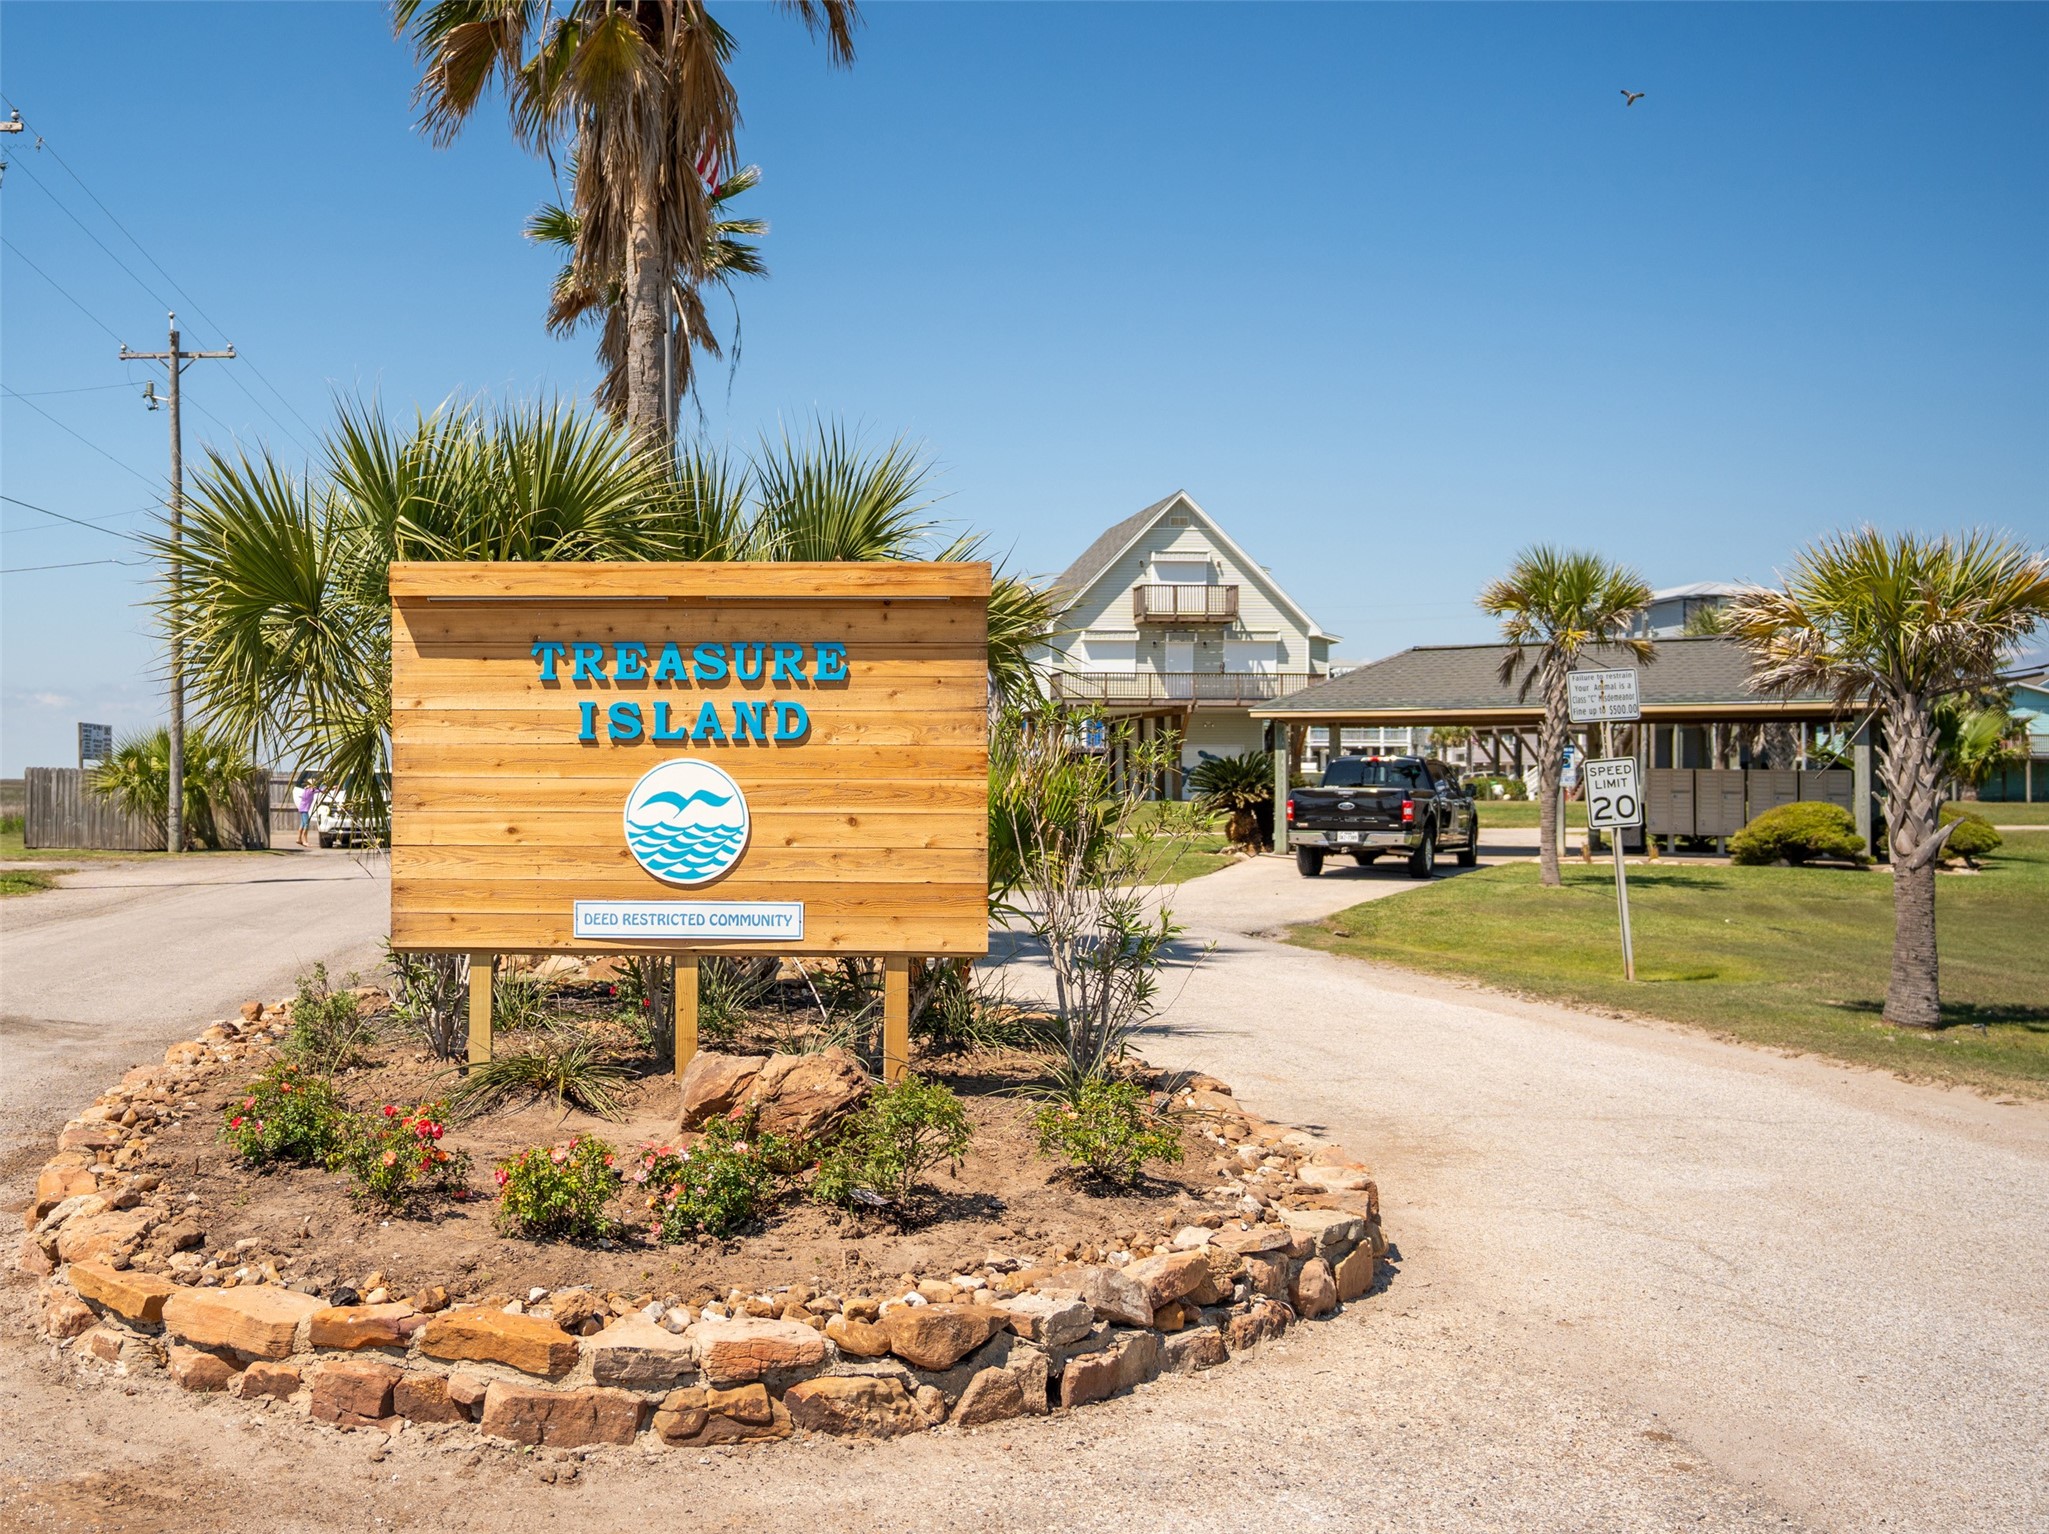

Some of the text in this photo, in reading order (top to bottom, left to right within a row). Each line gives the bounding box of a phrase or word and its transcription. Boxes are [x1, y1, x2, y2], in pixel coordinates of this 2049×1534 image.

[531, 642, 848, 680] TREASURE
[1572, 693, 1635, 704] Class "C" Msdemeanor
[1573, 704, 1637, 716] Fine up to $500.00
[578, 701, 809, 740] ISLAND
[1590, 764, 1632, 777] SPEED
[1595, 778, 1627, 790] LIMIT
[1592, 795, 1636, 820] 20
[584, 913, 793, 927] DEED RESTRICTED COMMUNITY
